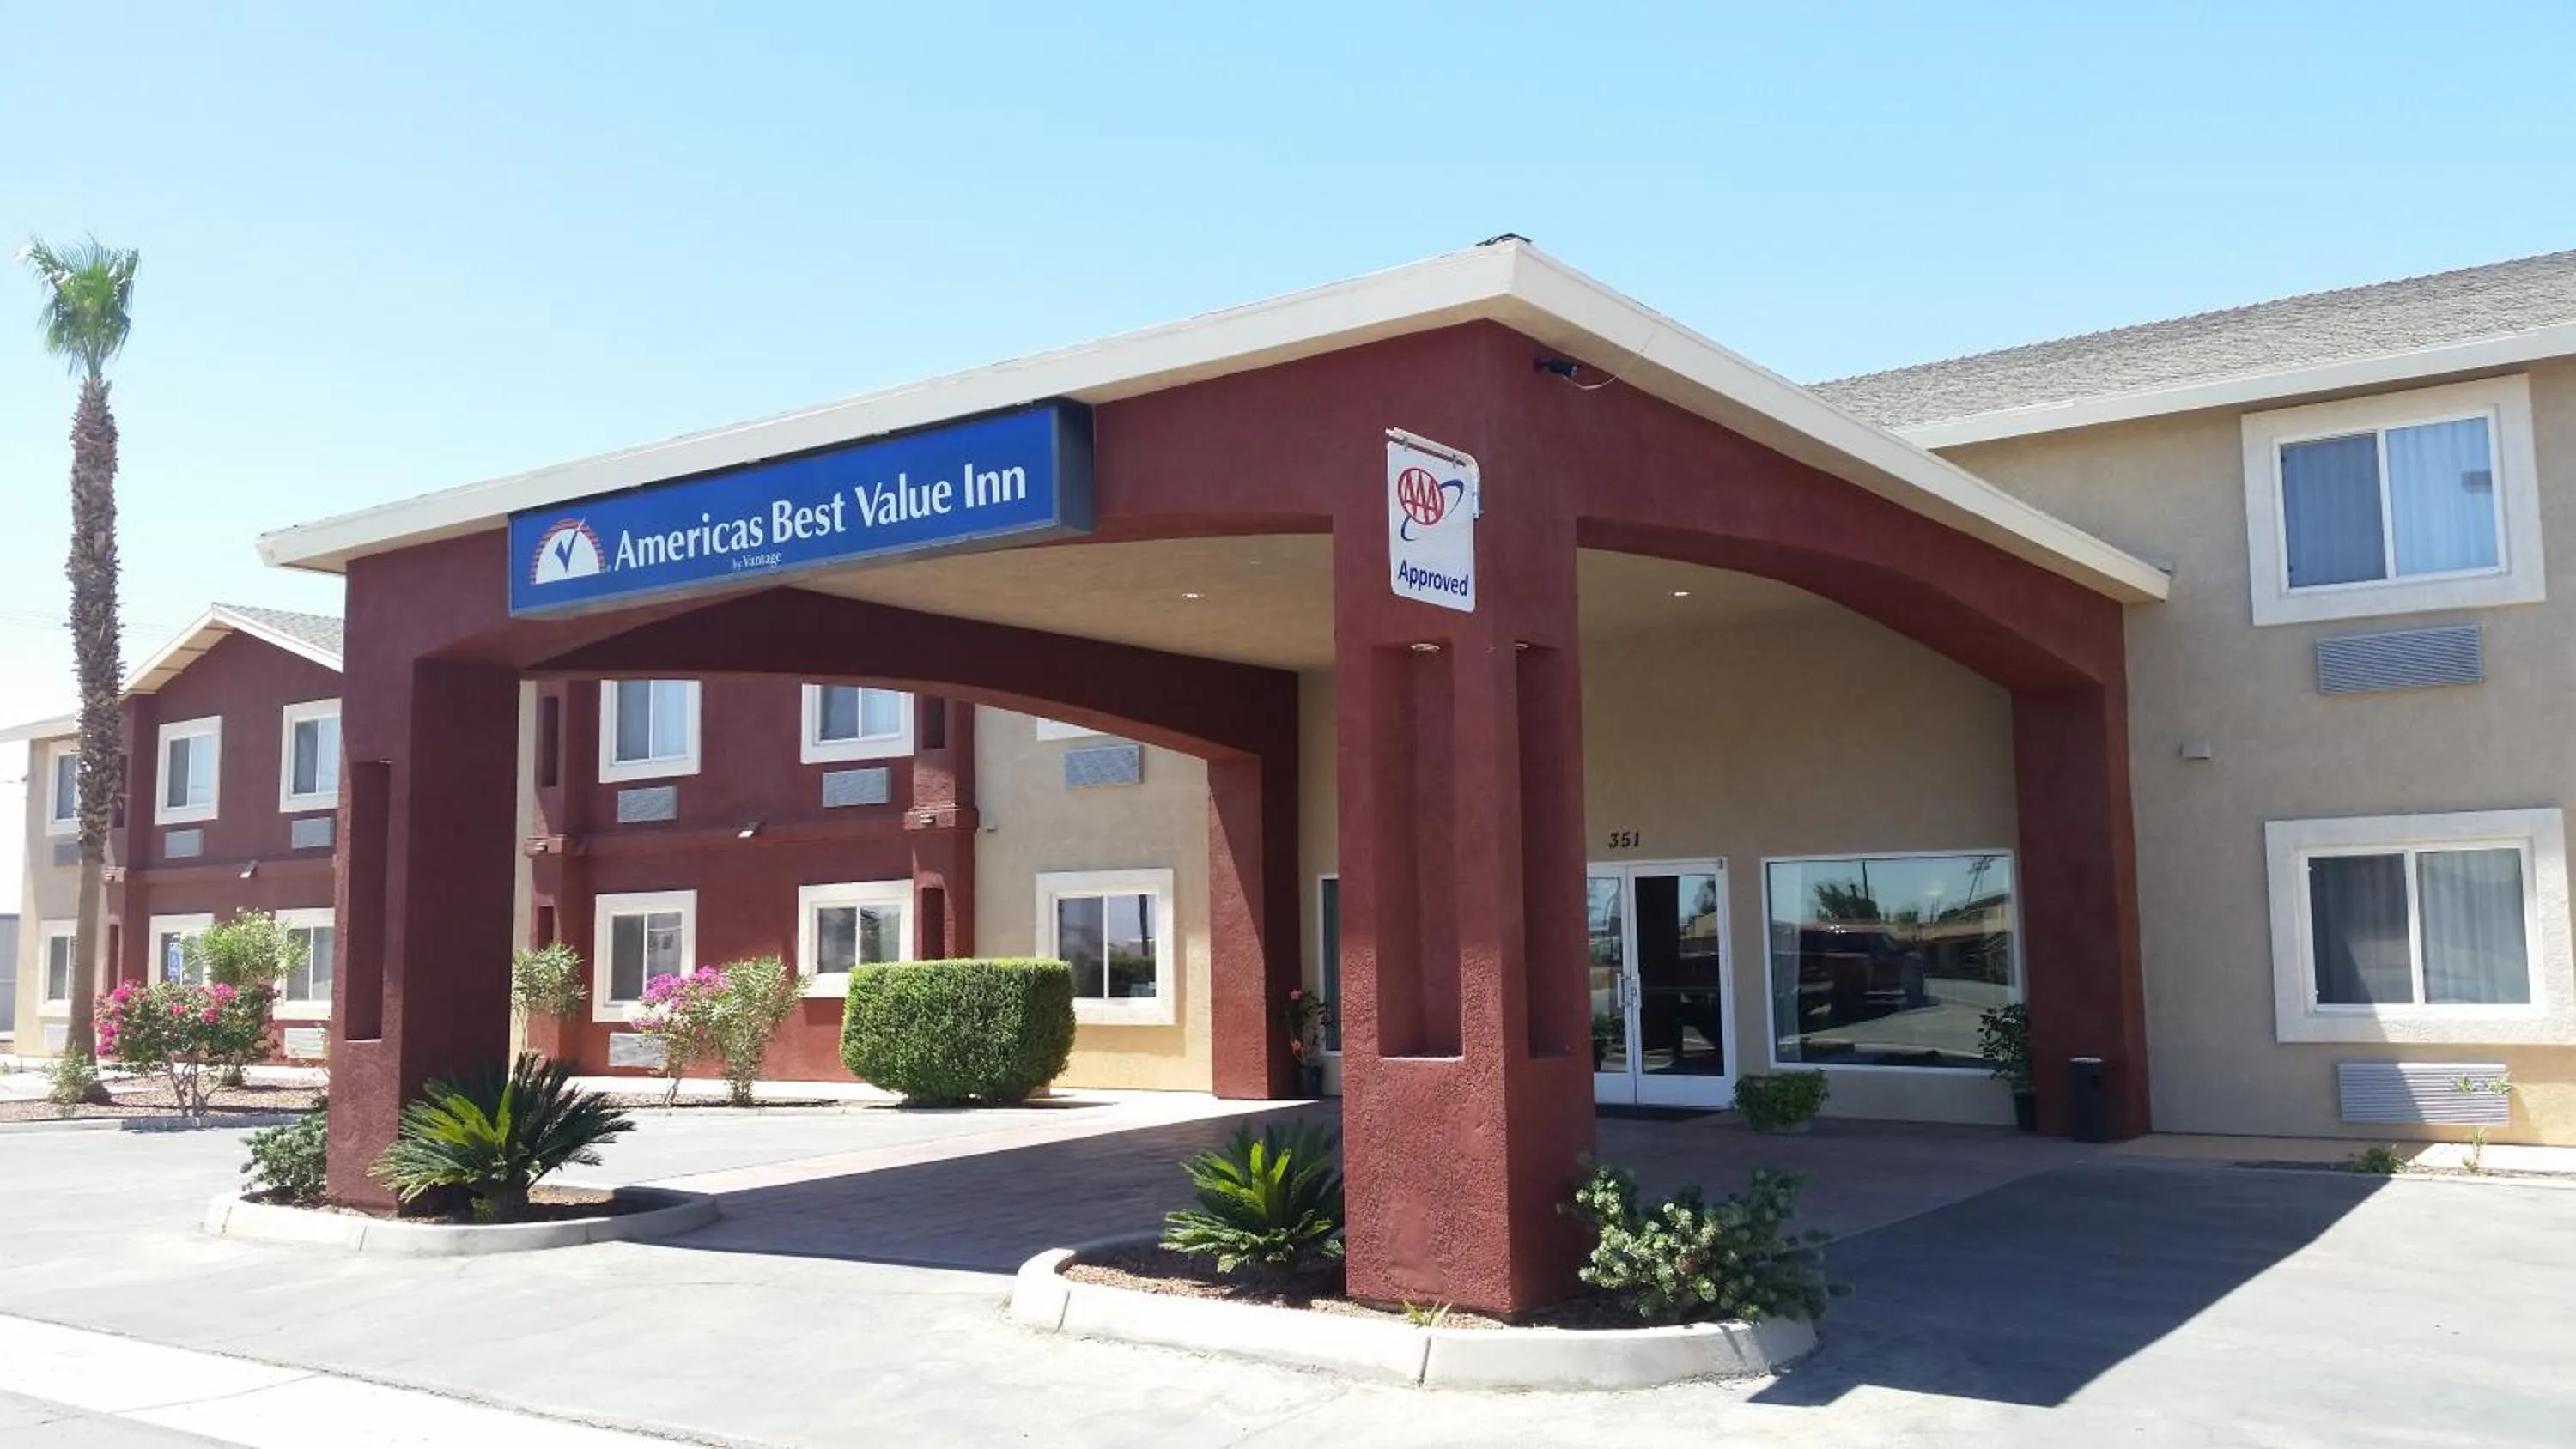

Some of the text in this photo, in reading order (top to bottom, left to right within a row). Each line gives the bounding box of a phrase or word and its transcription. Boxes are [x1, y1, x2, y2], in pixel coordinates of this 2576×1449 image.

[1402, 470, 1442, 524] AAA
[614, 463, 1026, 571] Americas Best Value Inn
[742, 552, 782, 568] Vantage
[1398, 559, 1468, 597] Approved
[1608, 831, 1640, 848] 351
